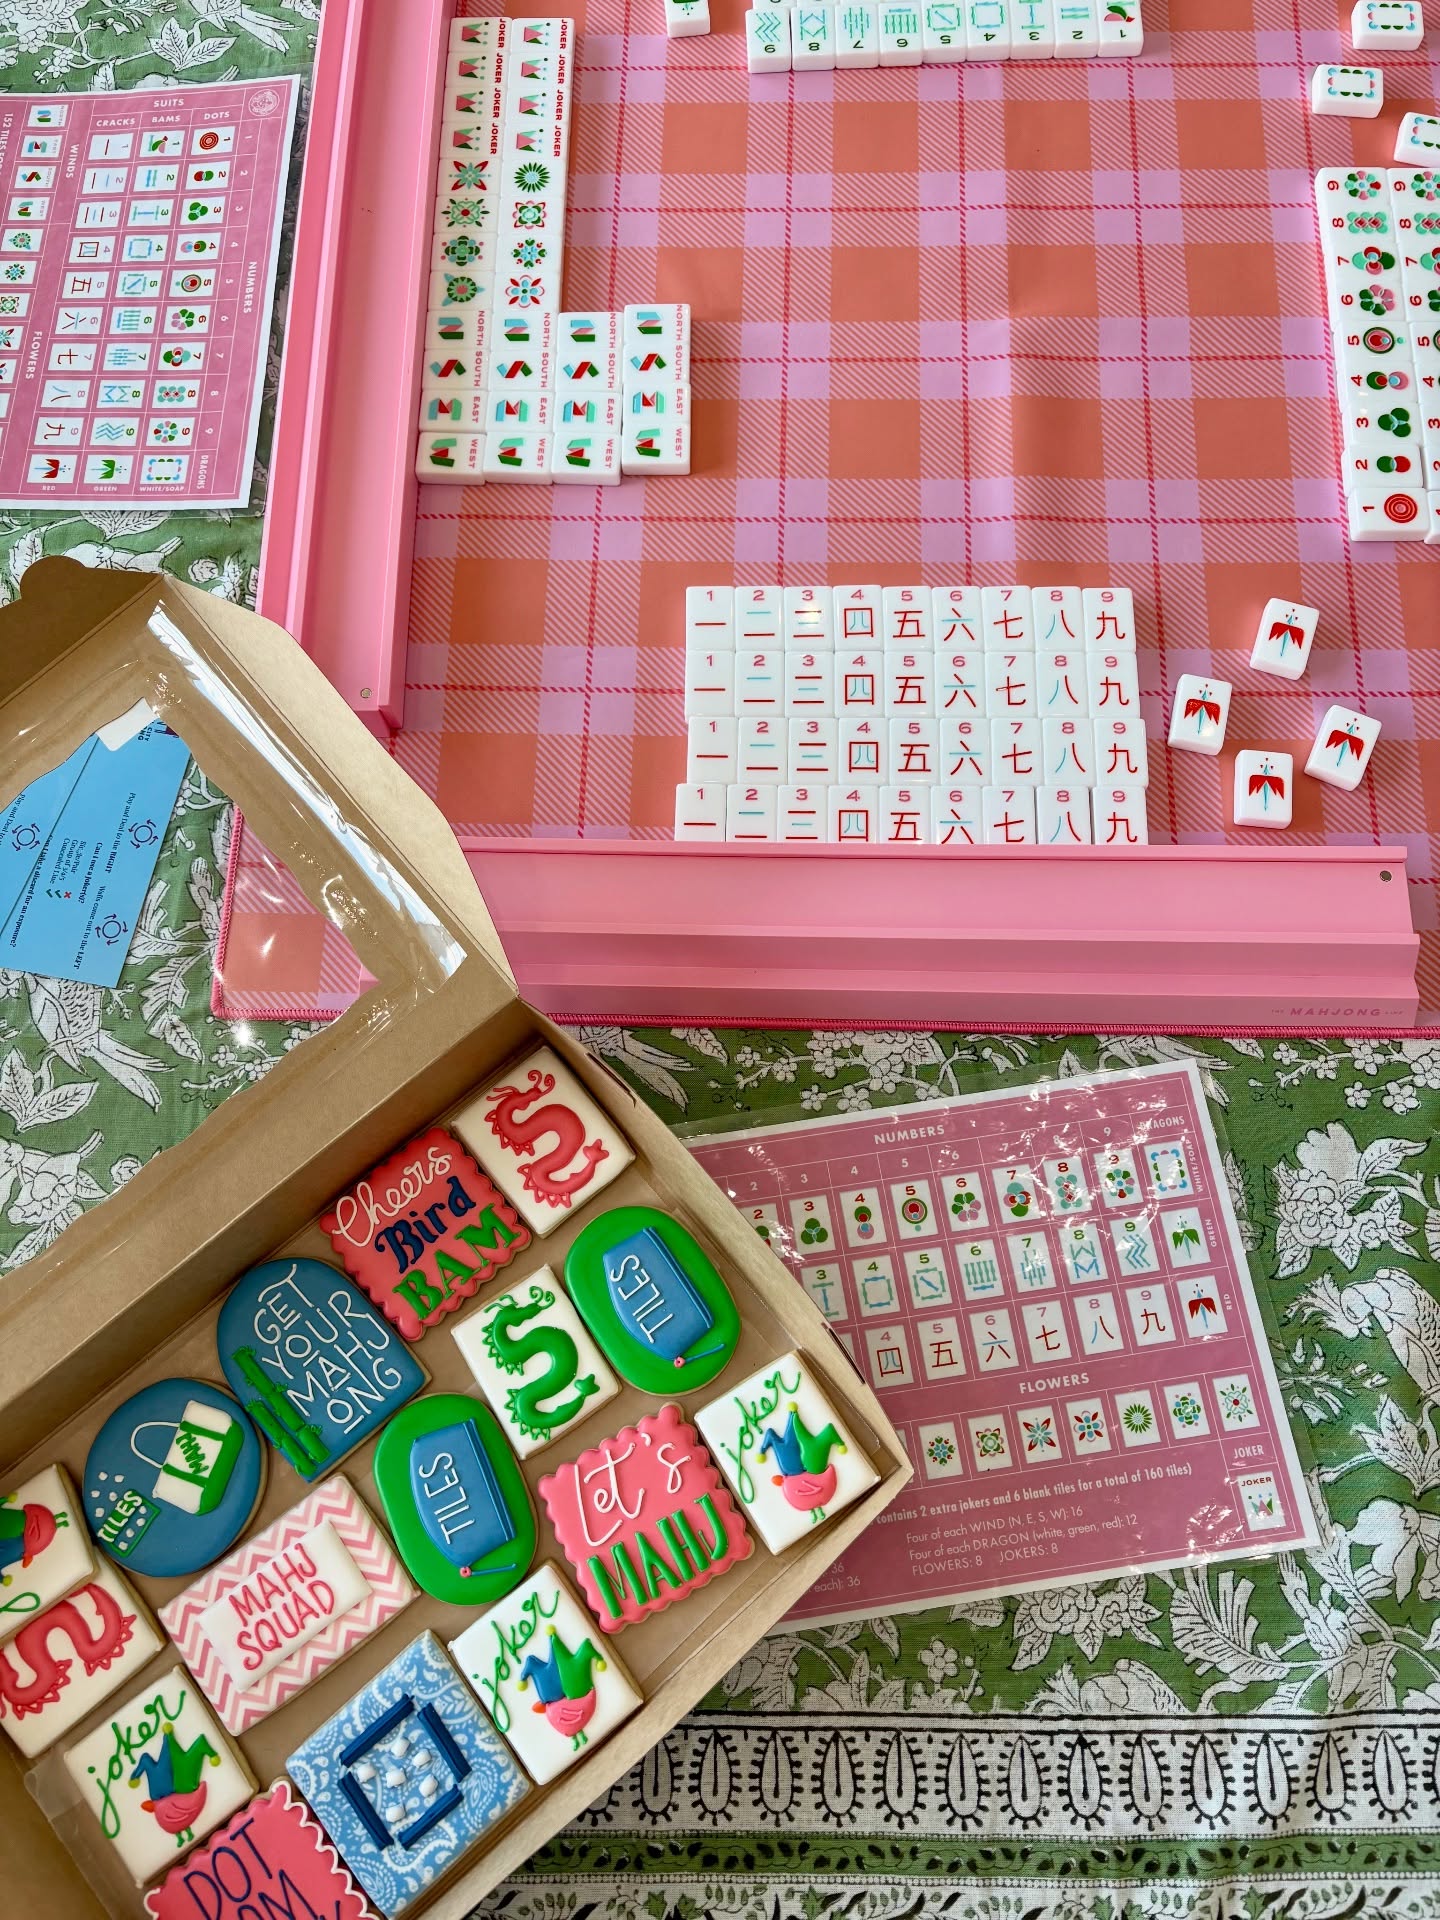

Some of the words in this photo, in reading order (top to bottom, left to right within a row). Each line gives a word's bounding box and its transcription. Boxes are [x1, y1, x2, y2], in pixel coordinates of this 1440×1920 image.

[497, 18, 506, 48] JOKER
[559, 19, 567, 50] JOKER
[808, 42, 820, 51] 8
[852, 40, 864, 49] 7
[896, 38, 908, 48] 6
[940, 35, 951, 44] 5
[984, 32, 996, 41] 4
[1028, 31, 1040, 41] 3
[1071, 30, 1083, 39] 2
[1118, 29, 1126, 38] 1
[764, 44, 776, 53] 9
[495, 53, 503, 84] JOKER
[557, 54, 566, 84] JOKER
[153, 98, 185, 108] SUITS
[492, 87, 501, 119] JOKER
[555, 89, 563, 121] JOKER
[3, 113, 13, 128] 152
[96, 117, 136, 127] CRACKS
[151, 115, 181, 123] BAMS
[203, 111, 230, 120] DOTS
[490, 122, 499, 155] JOKER
[553, 125, 561, 157] JOKER
[65, 143, 80, 179] WINDS
[1327, 180, 1340, 190] 9
[1332, 218, 1344, 228] 8
[1337, 256, 1350, 266] 7
[244, 261, 257, 315] NUMBERS
[1341, 294, 1353, 305] 6
[476, 310, 485, 346] NORTH
[542, 313, 550, 348] NORTH
[608, 313, 616, 349] NORTH
[675, 305, 683, 341] NORTH
[1348, 335, 1360, 345] 5
[26, 331, 42, 380] FLOWERS
[474, 351, 482, 387] SOUTH
[540, 353, 549, 388] SOUTH
[675, 345, 683, 381] SOUTH
[607, 353, 615, 389] SOUTH
[1351, 375, 1363, 387] 4
[472, 397, 480, 424] EAST
[539, 397, 547, 425] EAST
[607, 399, 615, 425] EAST
[675, 389, 683, 415] EAST
[1356, 417, 1369, 428] 3
[468, 439, 478, 469] WEST
[537, 439, 546, 469] WEST
[605, 440, 614, 469] WEST
[674, 428, 682, 457] WEST
[197, 454, 209, 489] DRAGONS
[1356, 459, 1368, 470] 2
[1362, 505, 1375, 513] 1
[707, 591, 713, 601] 1
[753, 590, 765, 601] 2
[802, 590, 814, 601] 3
[851, 590, 864, 600] 4
[901, 591, 913, 601] 5
[950, 590, 963, 601] 6
[1001, 590, 1013, 601] 7
[1050, 590, 1064, 601] 8
[1101, 591, 1115, 602] 9
[843, 608, 874, 638] 四
[893, 610, 926, 638] 五
[941, 608, 975, 641] 六
[1095, 611, 1126, 639] 九
[94, 842, 103, 855] Can
[105, 851, 117, 873] RIGHT
[74, 951, 84, 970] LEFT
[1290, 1008, 1381, 1016] MAHJONG
[874, 1125, 945, 1145] NUMBERS
[1186, 1139, 1203, 1193] WHITE/SOAP
[332, 1146, 451, 1247] Cheers
[375, 1176, 476, 1274] Bird
[1208, 1219, 1217, 1247] GREEN
[393, 1204, 521, 1321] BAM
[255, 1264, 314, 1344] GET
[610, 1254, 673, 1343] TILES
[262, 1290, 369, 1380] YOUR
[287, 1313, 390, 1416] MAHJ
[327, 1358, 402, 1434] ONG
[1019, 1373, 1090, 1394] FLOWERS
[720, 1367, 801, 1504] joker
[1233, 1445, 1264, 1459] JOKER
[573, 1431, 692, 1547] Let's
[876, 1508, 918, 1524] contains
[920, 1506, 927, 1517] 2
[930, 1503, 958, 1516] extra
[958, 1498, 990, 1514] jokers
[993, 1491, 1012, 1505] and
[1014, 1490, 1021, 1500] 6
[1022, 1485, 1051, 1500] blank
[1053, 1480, 1076, 1496] tiles
[1078, 1479, 1093, 1491] for
[1095, 1480, 1103, 1488] a
[1104, 1472, 1129, 1487] total
[1131, 1469, 1142, 1482] of
[1144, 1466, 1164, 1480] 160
[1165, 1462, 1193, 1477] tiles)
[1241, 1476, 1272, 1487] JOKER
[418, 1452, 475, 1545] TILES
[97, 1491, 143, 1542] TILES
[906, 1531, 928, 1544] Four
[931, 1527, 942, 1540] of
[943, 1523, 968, 1537] each
[969, 1518, 1006, 1533] WIND
[1008, 1515, 1024, 1529] (N,
[1026, 1513, 1036, 1525] E,
[1038, 1511, 1048, 1524] S,
[1071, 1505, 1083, 1516] 16
[909, 1549, 932, 1561] Four
[934, 1545, 945, 1557] of
[947, 1540, 971, 1555] each
[973, 1531, 1030, 1551] DRAGON
[1032, 1526, 1066, 1542] (white,
[1068, 1522, 1099, 1538] green,
[1102, 1515, 1125, 1529] red):
[1126, 1514, 1138, 1525] 12
[587, 1494, 730, 1620] MAHJ
[831, 1562, 845, 1574] 36
[912, 1556, 973, 1576] FLOWERS:
[975, 1555, 983, 1566] 8
[1000, 1545, 1049, 1562] JOKERS:
[1051, 1543, 1059, 1554] 8
[229, 1543, 318, 1628] MAHJ
[847, 1575, 861, 1587] 36
[237, 1580, 336, 1671] SQUAD
[473, 1589, 561, 1733] joker
[87, 1690, 186, 1839] joker
[183, 1817, 273, 1920] DOT
